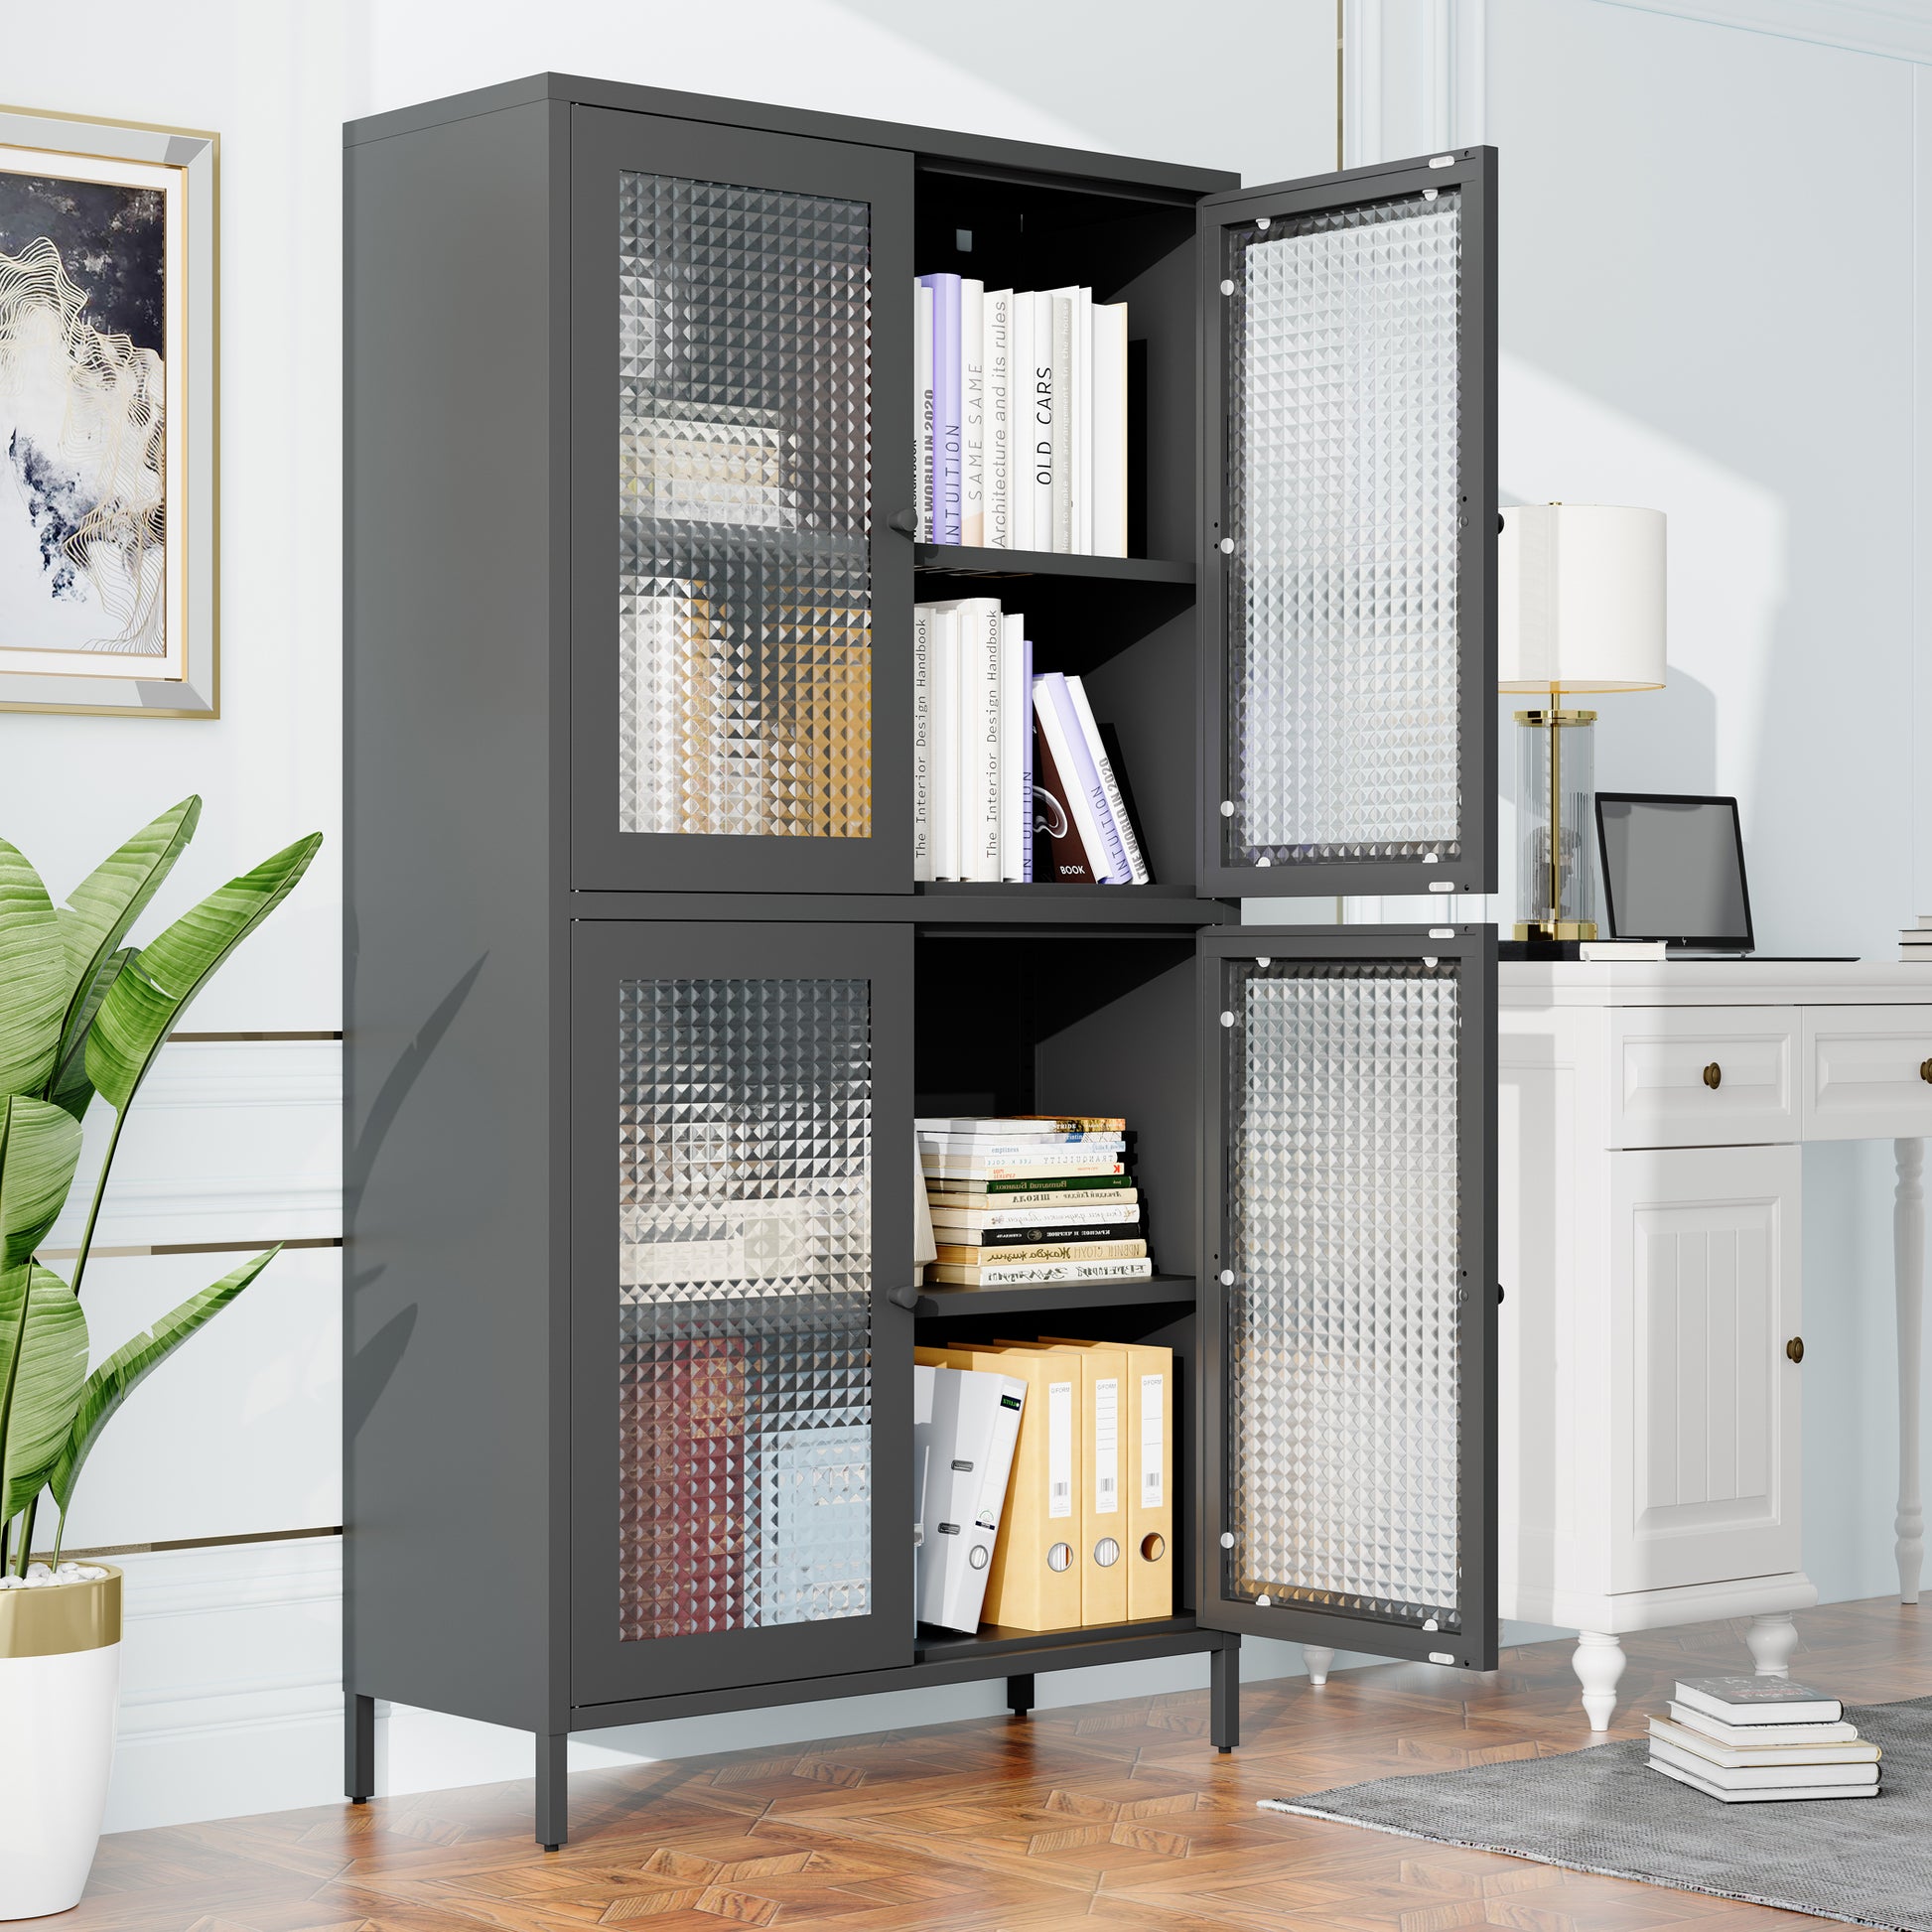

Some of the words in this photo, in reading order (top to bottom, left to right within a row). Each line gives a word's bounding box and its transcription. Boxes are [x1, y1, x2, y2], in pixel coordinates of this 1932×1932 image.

[991, 300, 1007, 349] rules
[991, 355, 1007, 379] its
[924, 389, 934, 431] 2020
[968, 363, 983, 425] SAME
[991, 385, 1007, 422] and
[1036, 366, 1052, 425] CARS
[924, 435, 934, 451] IN
[1036, 441, 1052, 485] OLD
[924, 456, 934, 512] WORLD
[945, 424, 960, 545] INTUITION
[968, 440, 983, 501] SAME
[991, 428, 1007, 548] Architecture
[924, 515, 934, 544] THE
[915, 619, 926, 687] Handbook
[986, 610, 997, 681] Handbook
[915, 696, 928, 747] Design
[986, 690, 999, 743] Design
[915, 757, 926, 824] Interior
[986, 753, 997, 823] Interior
[1099, 757, 1118, 792] 2020
[1111, 791, 1123, 808] IN
[915, 833, 926, 858] The
[986, 833, 997, 858] The
[1091, 785, 1130, 878] INTUITION
[1116, 807, 1139, 855] WORLD
[1059, 865, 1085, 875] BOOK
[1132, 853, 1147, 880] THE
